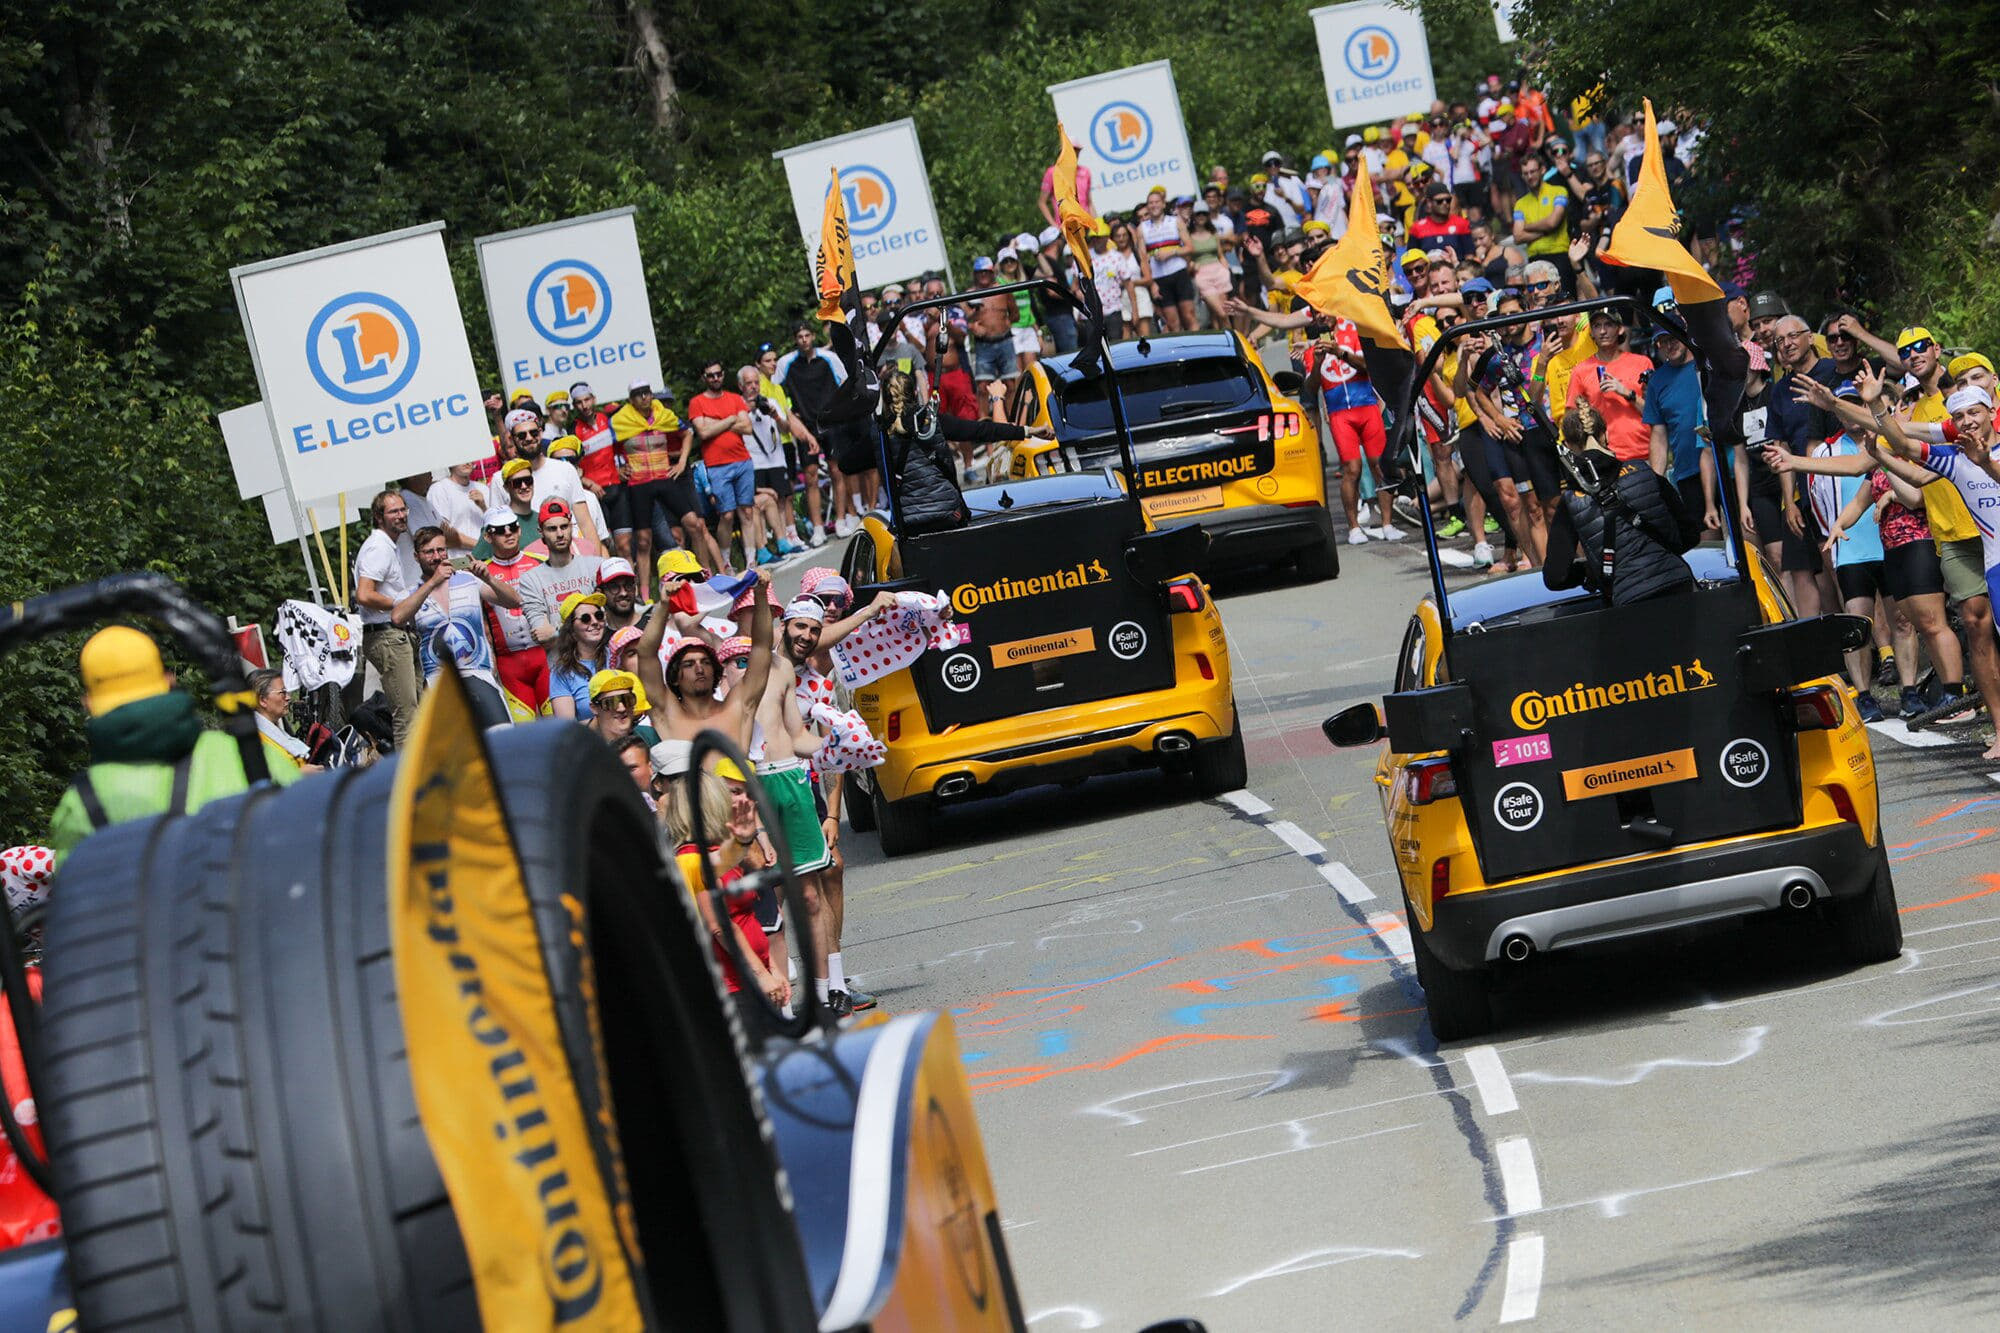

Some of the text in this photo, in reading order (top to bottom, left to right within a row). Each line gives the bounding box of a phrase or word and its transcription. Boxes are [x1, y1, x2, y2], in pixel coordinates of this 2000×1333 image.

[514, 340, 647, 383] E.Leclerc
[293, 393, 470, 454] E.Leclerc
[1144, 454, 1257, 488] ELECTRIQUE
[1149, 494, 1201, 511] Continental
[952, 564, 1089, 614] Continental
[1115, 630, 1139, 642] #Safe
[1007, 638, 1069, 660] Continental
[1118, 641, 1139, 652] Tour
[949, 663, 973, 674] #Safe
[952, 673, 972, 683] Tour
[1511, 664, 1688, 730] Continental
[1515, 740, 1549, 759] 1013
[1729, 750, 1759, 765] #Safe
[1584, 761, 1663, 789] Continental
[1732, 763, 1759, 776] Tour
[1502, 793, 1533, 808] #Safe
[1506, 806, 1533, 820] Tour
